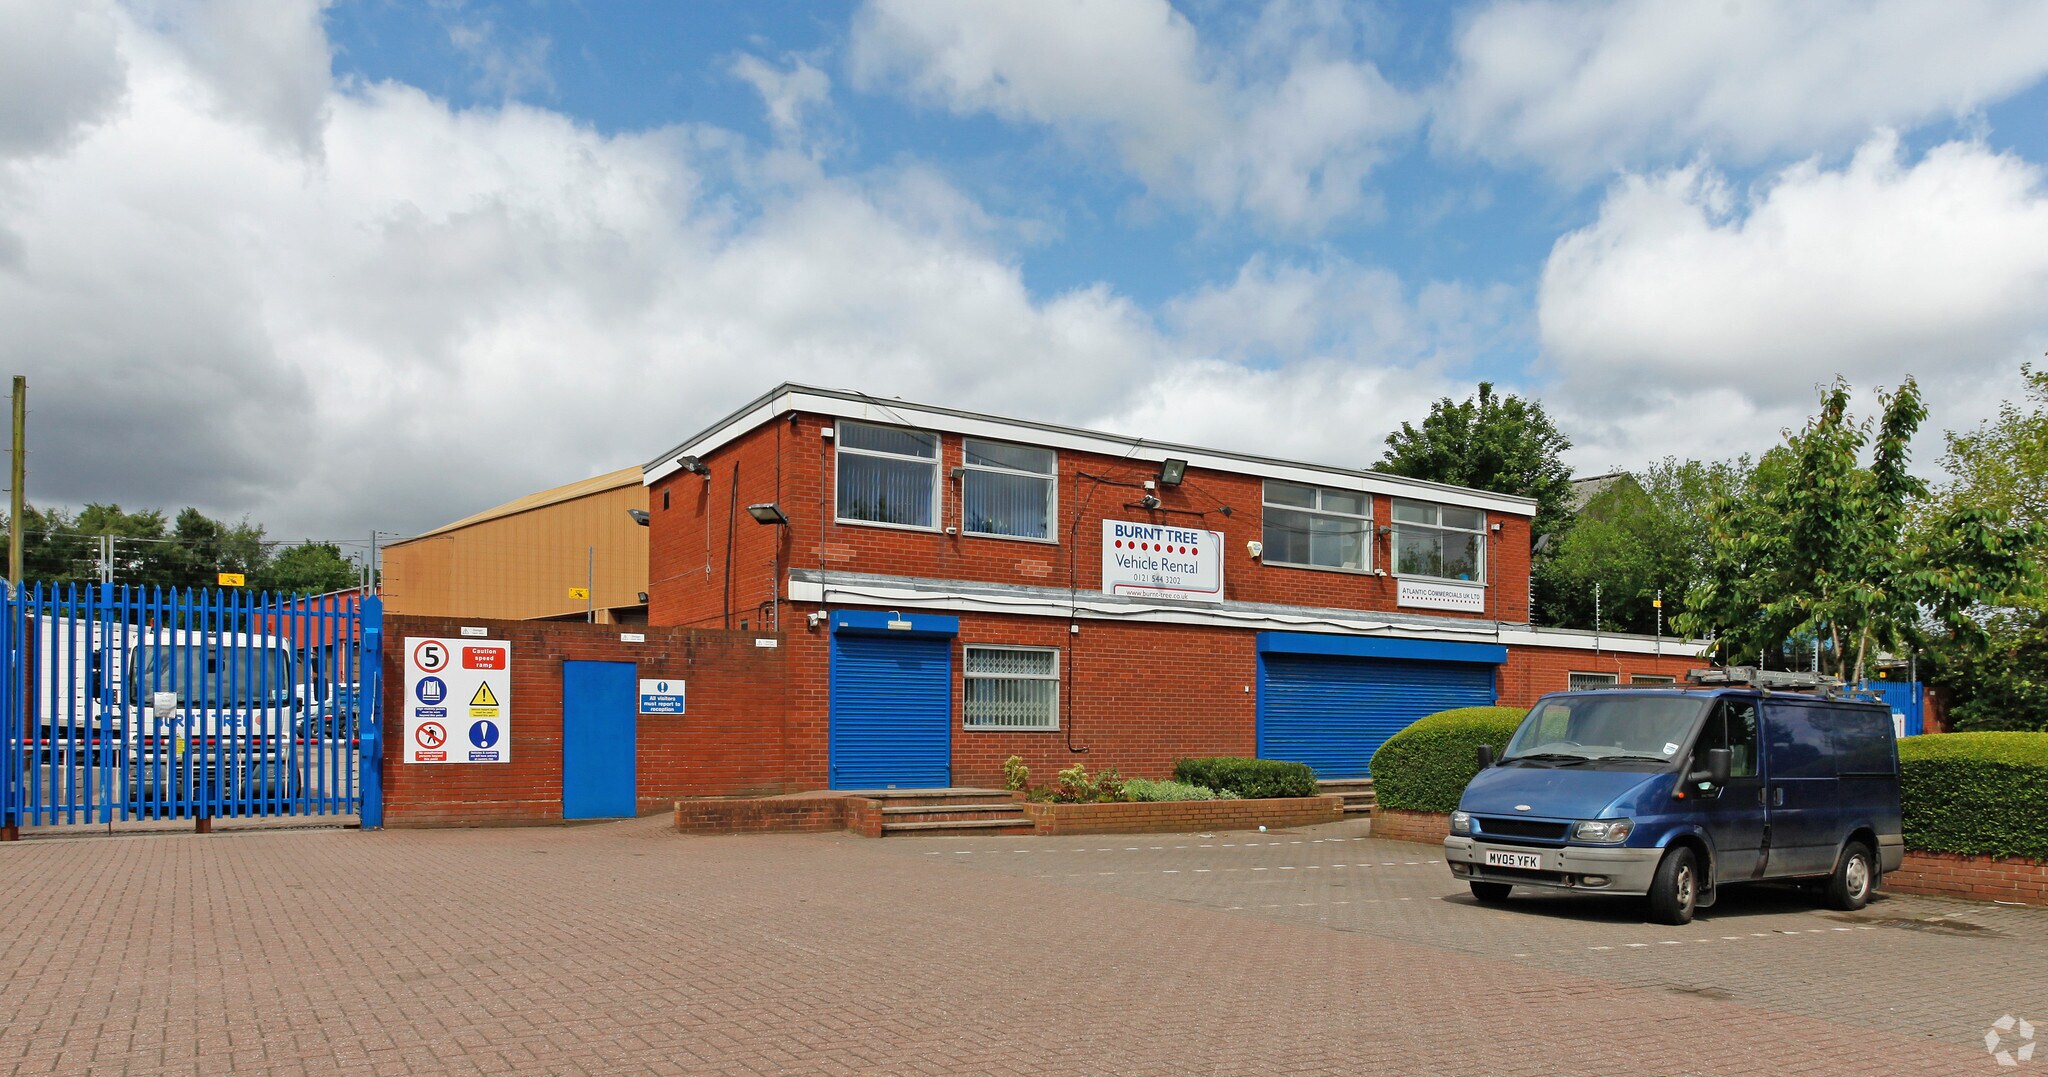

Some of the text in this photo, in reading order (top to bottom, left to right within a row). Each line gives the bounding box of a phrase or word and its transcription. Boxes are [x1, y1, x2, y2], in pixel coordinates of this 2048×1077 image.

[1115, 524, 1198, 545] BURNT TREE
[1115, 553, 1198, 574] Vehicle Rental
[1133, 573, 1181, 585] 0121 544 3202
[1402, 587, 1427, 596] ATLANTIC
[424, 646, 440, 668] 5
[1490, 852, 1537, 868] MV05 YFK
